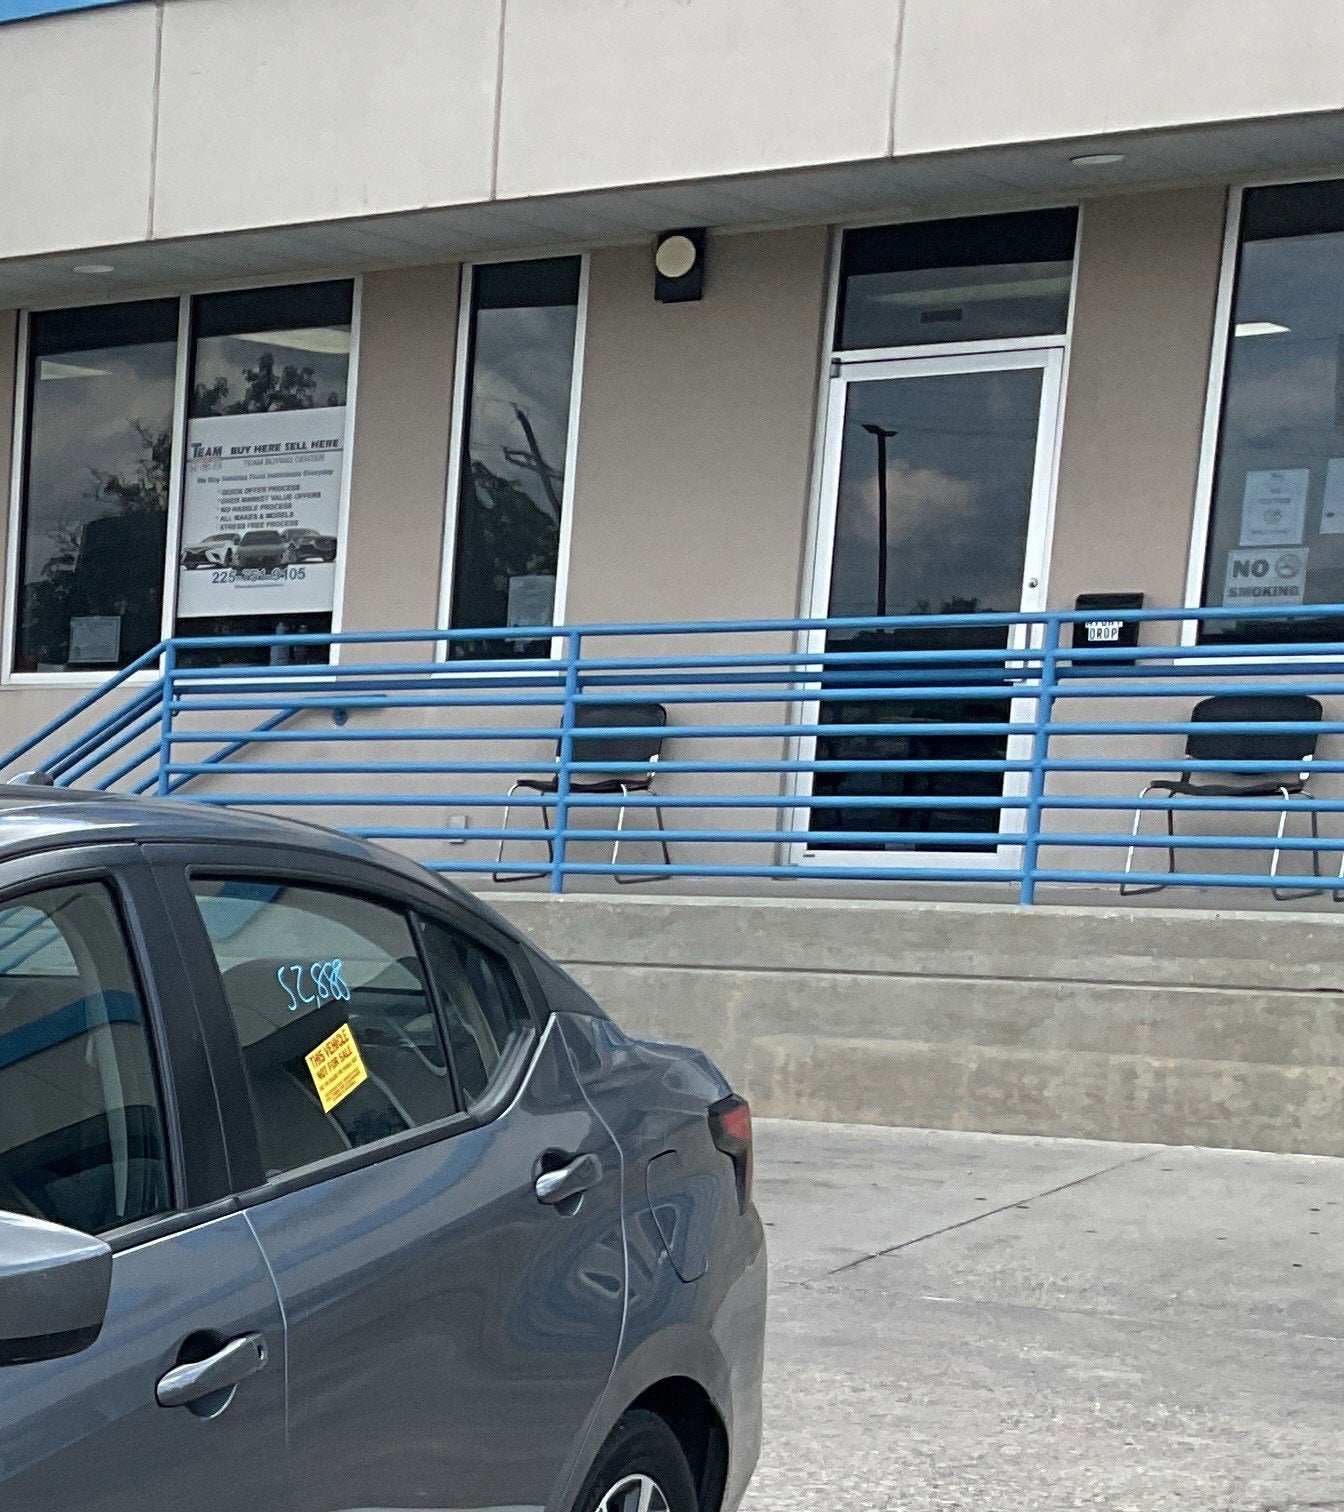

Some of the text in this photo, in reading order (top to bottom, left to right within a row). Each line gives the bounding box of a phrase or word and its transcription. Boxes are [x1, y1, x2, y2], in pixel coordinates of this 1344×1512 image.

[230, 439, 339, 455] BUY HERE SELL HERE
[1232, 559, 1269, 578] NO
[1228, 586, 1300, 597] SMOKING
[1089, 627, 1118, 640] DROP
